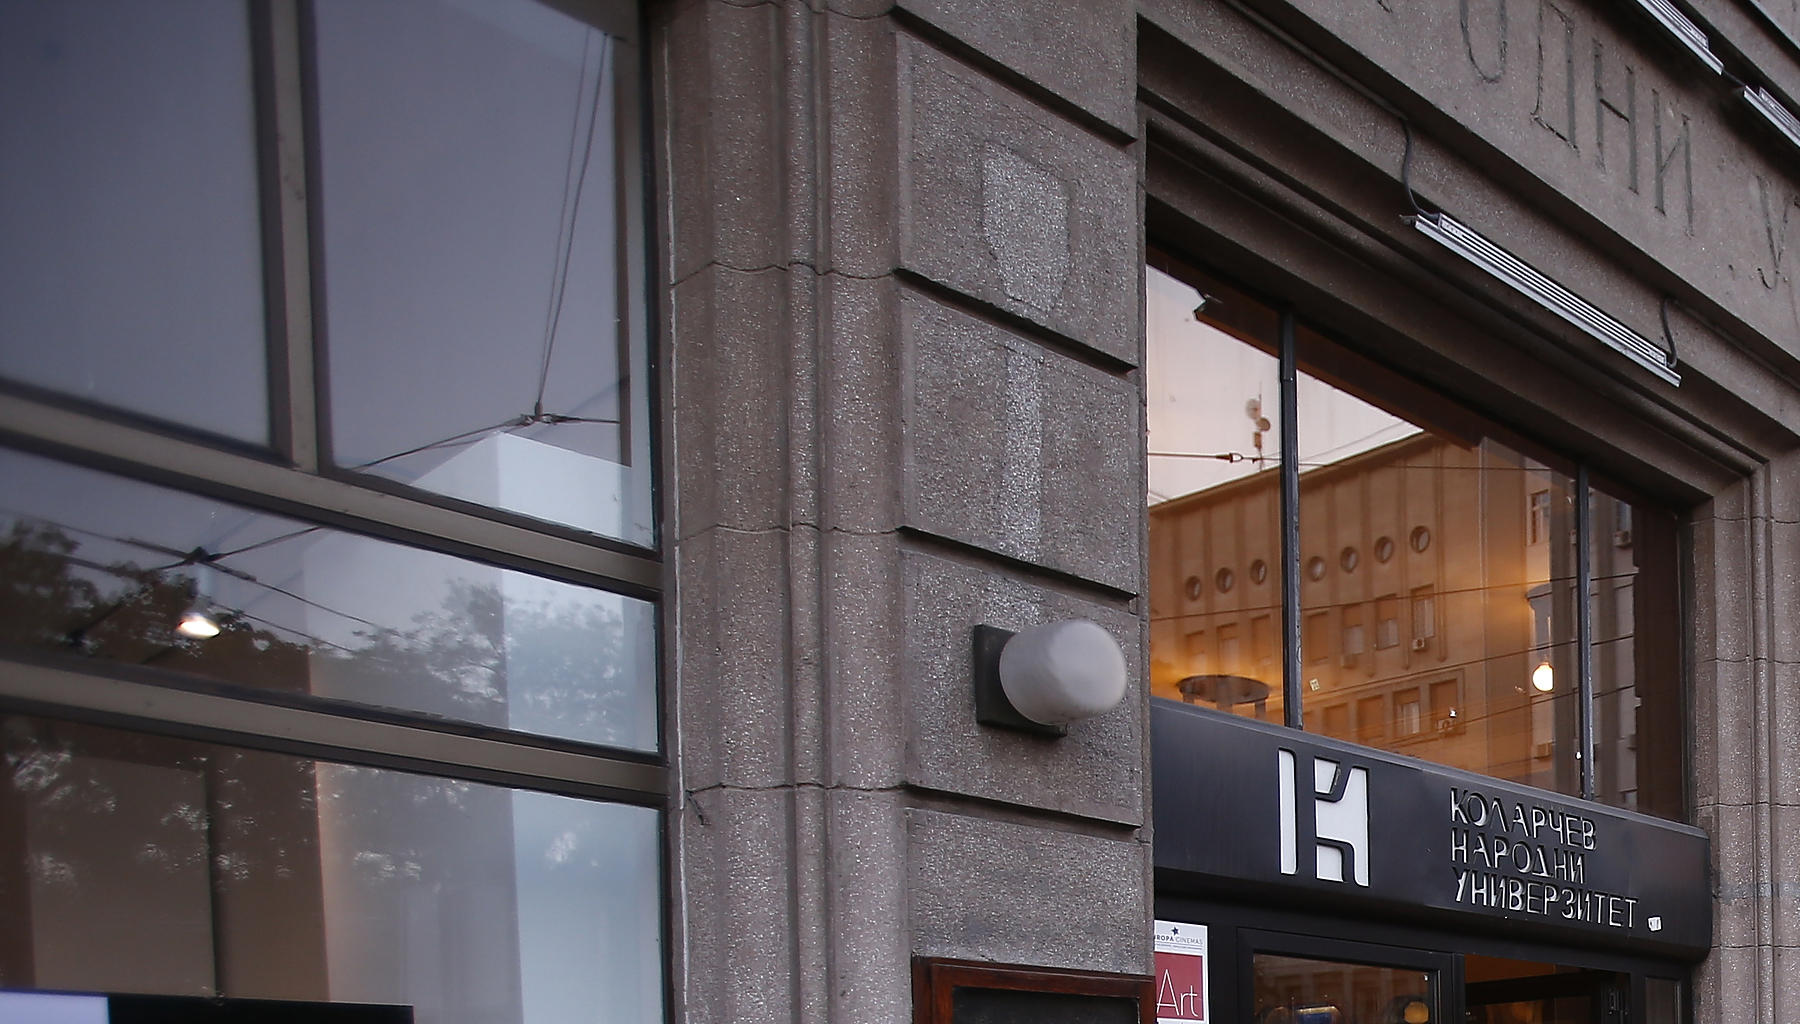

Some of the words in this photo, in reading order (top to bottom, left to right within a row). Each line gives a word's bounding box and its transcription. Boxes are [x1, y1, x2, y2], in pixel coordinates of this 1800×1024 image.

[1377, 0, 1695, 240] ОДНИ
[1450, 786, 1598, 852] КОЛАРЧЕВ
[1451, 828, 1587, 885] НАРОДНИ
[1451, 866, 1640, 929] УНИВЕРЗИТЕТ
[1154, 933, 1174, 942] ROPA
[1175, 936, 1204, 946] CINEMAS
[1156, 968, 1199, 1018] Art
